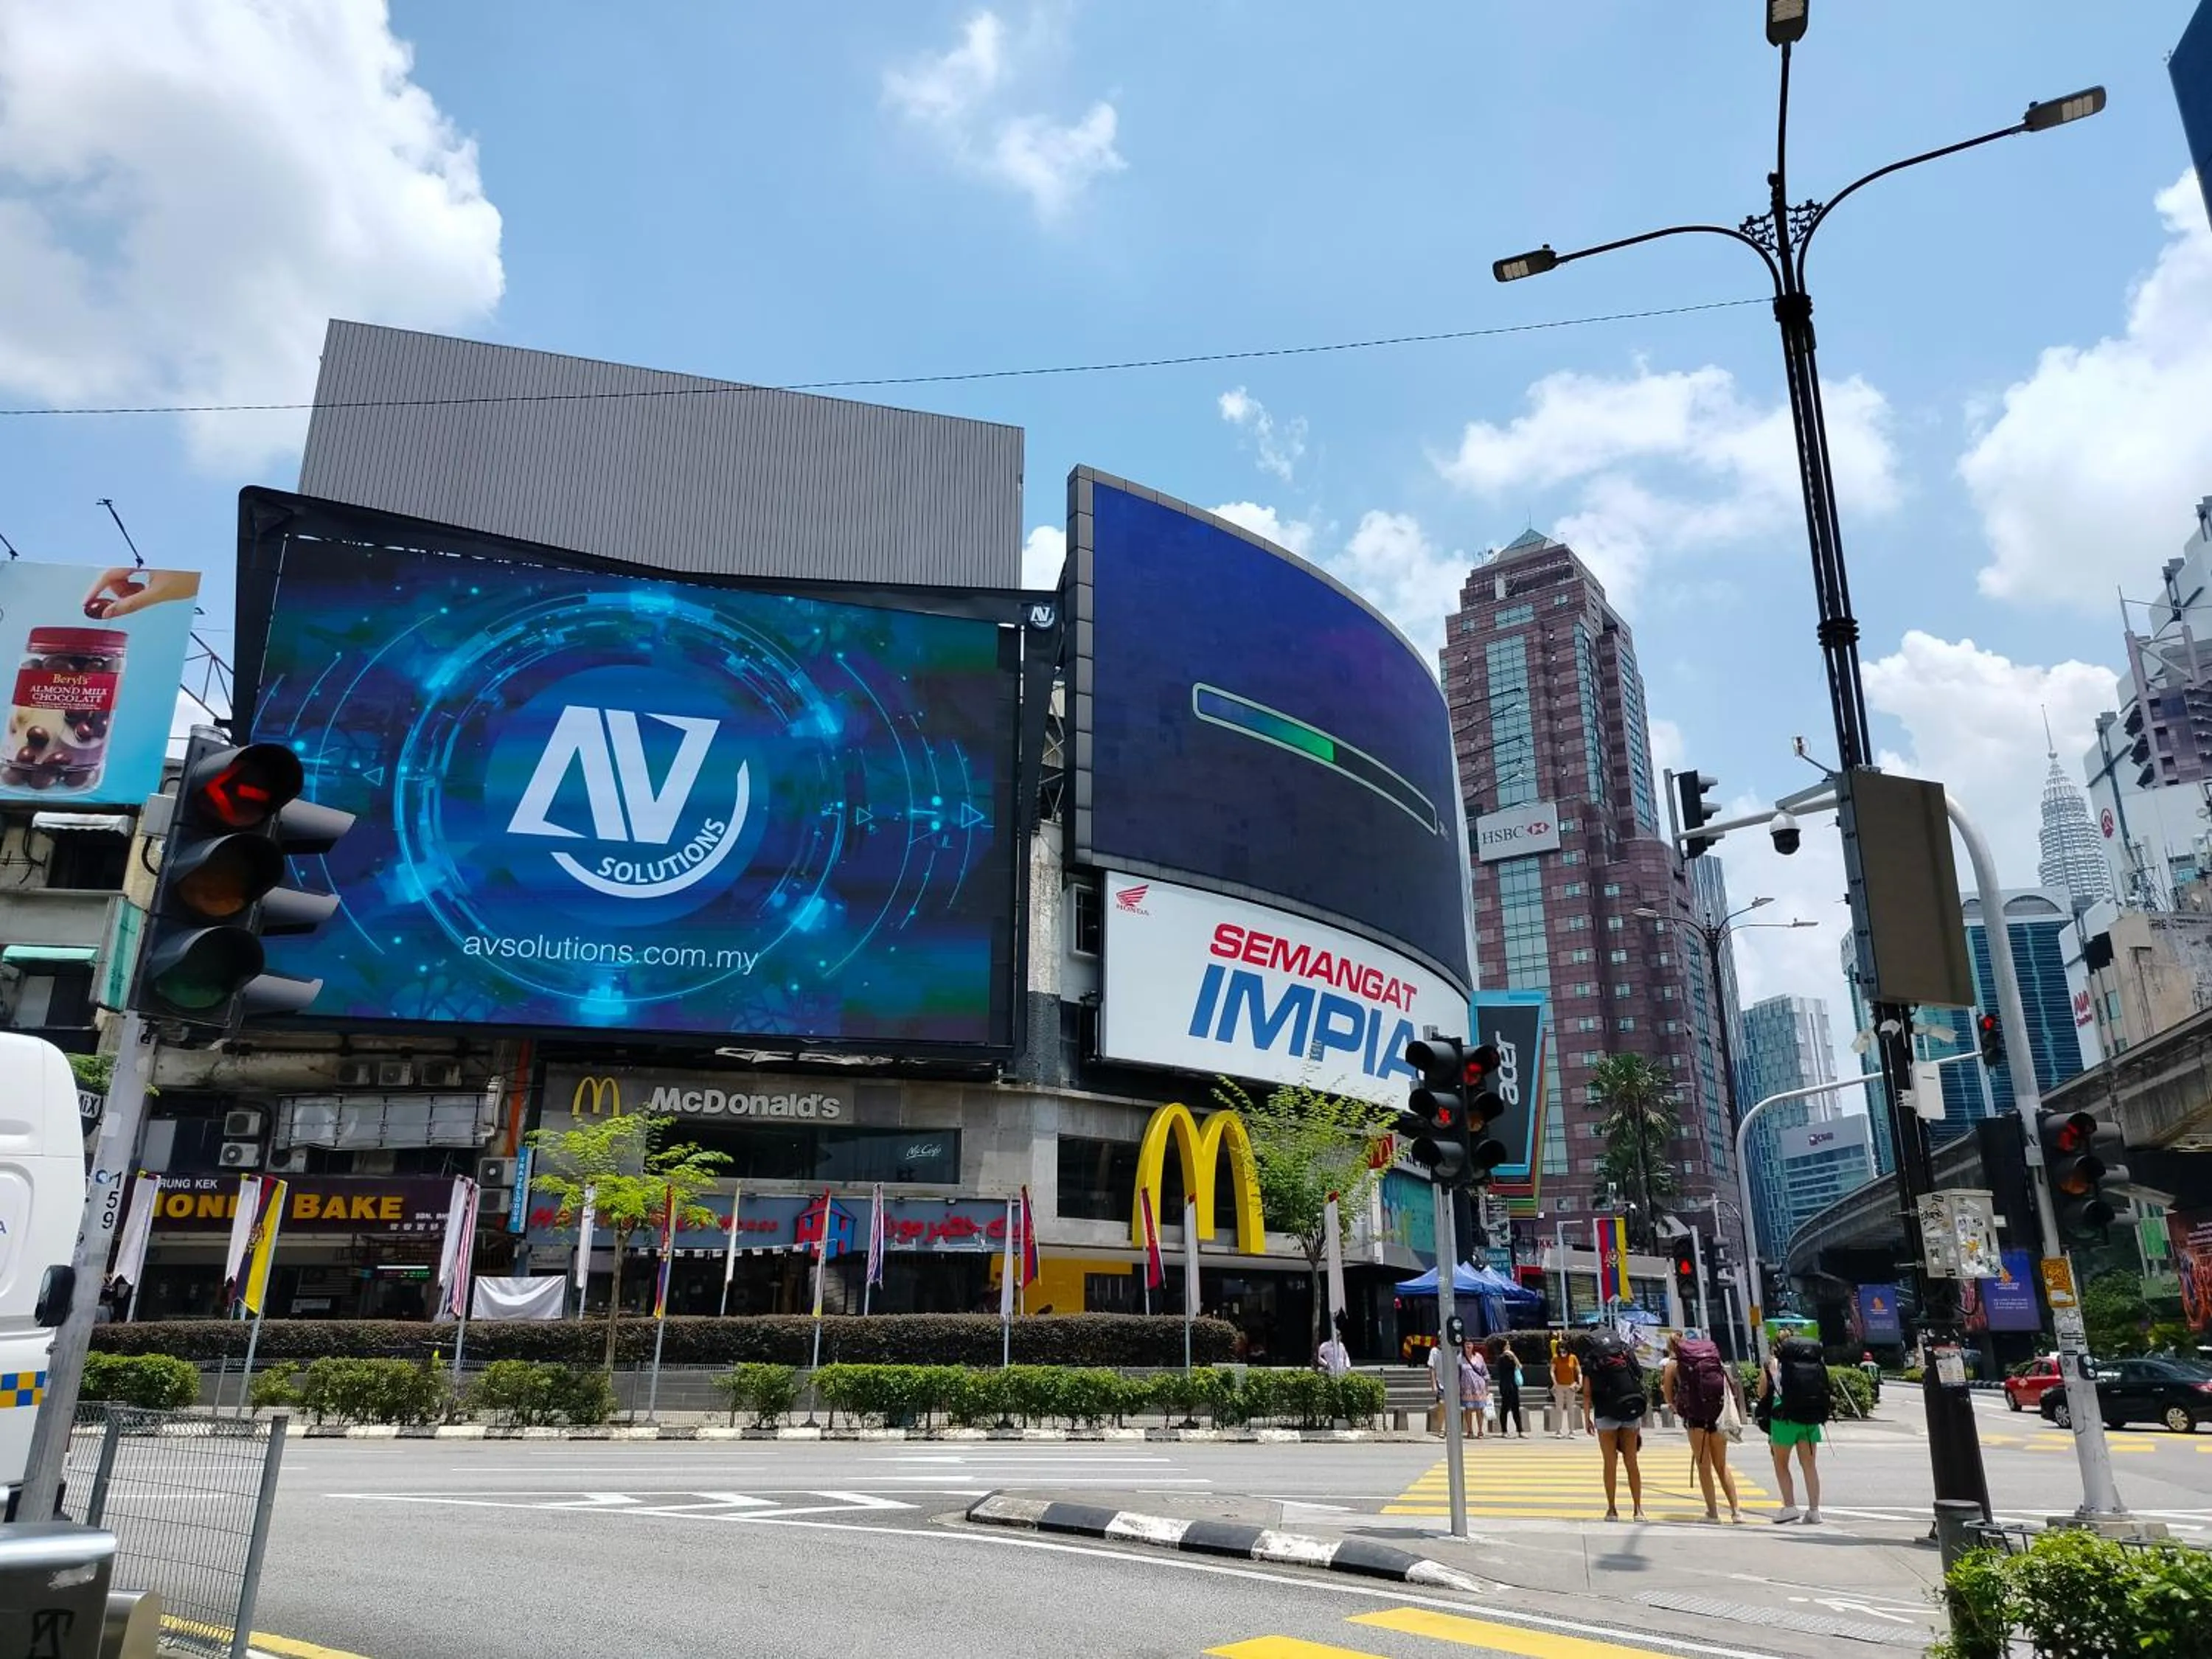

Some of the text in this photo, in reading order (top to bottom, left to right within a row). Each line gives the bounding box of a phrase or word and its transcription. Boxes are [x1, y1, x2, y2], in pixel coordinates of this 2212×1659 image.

[29, 684, 80, 695] ALMOND
[32, 692, 102, 703] CHOCOLATE
[1482, 825, 1524, 844] HSBC
[597, 817, 726, 884] SOLUTIONS
[1116, 903, 1150, 916] HONDA
[462, 933, 759, 976] avsolutions.com.my
[1209, 922, 1418, 1013] SEMANGAT
[1188, 963, 1420, 1081] IMPIA
[1495, 1030, 1519, 1105] acer
[649, 1086, 841, 1119] McDonald's
[195, 1179, 218, 1189] KEK
[293, 1194, 404, 1220] BAKE
